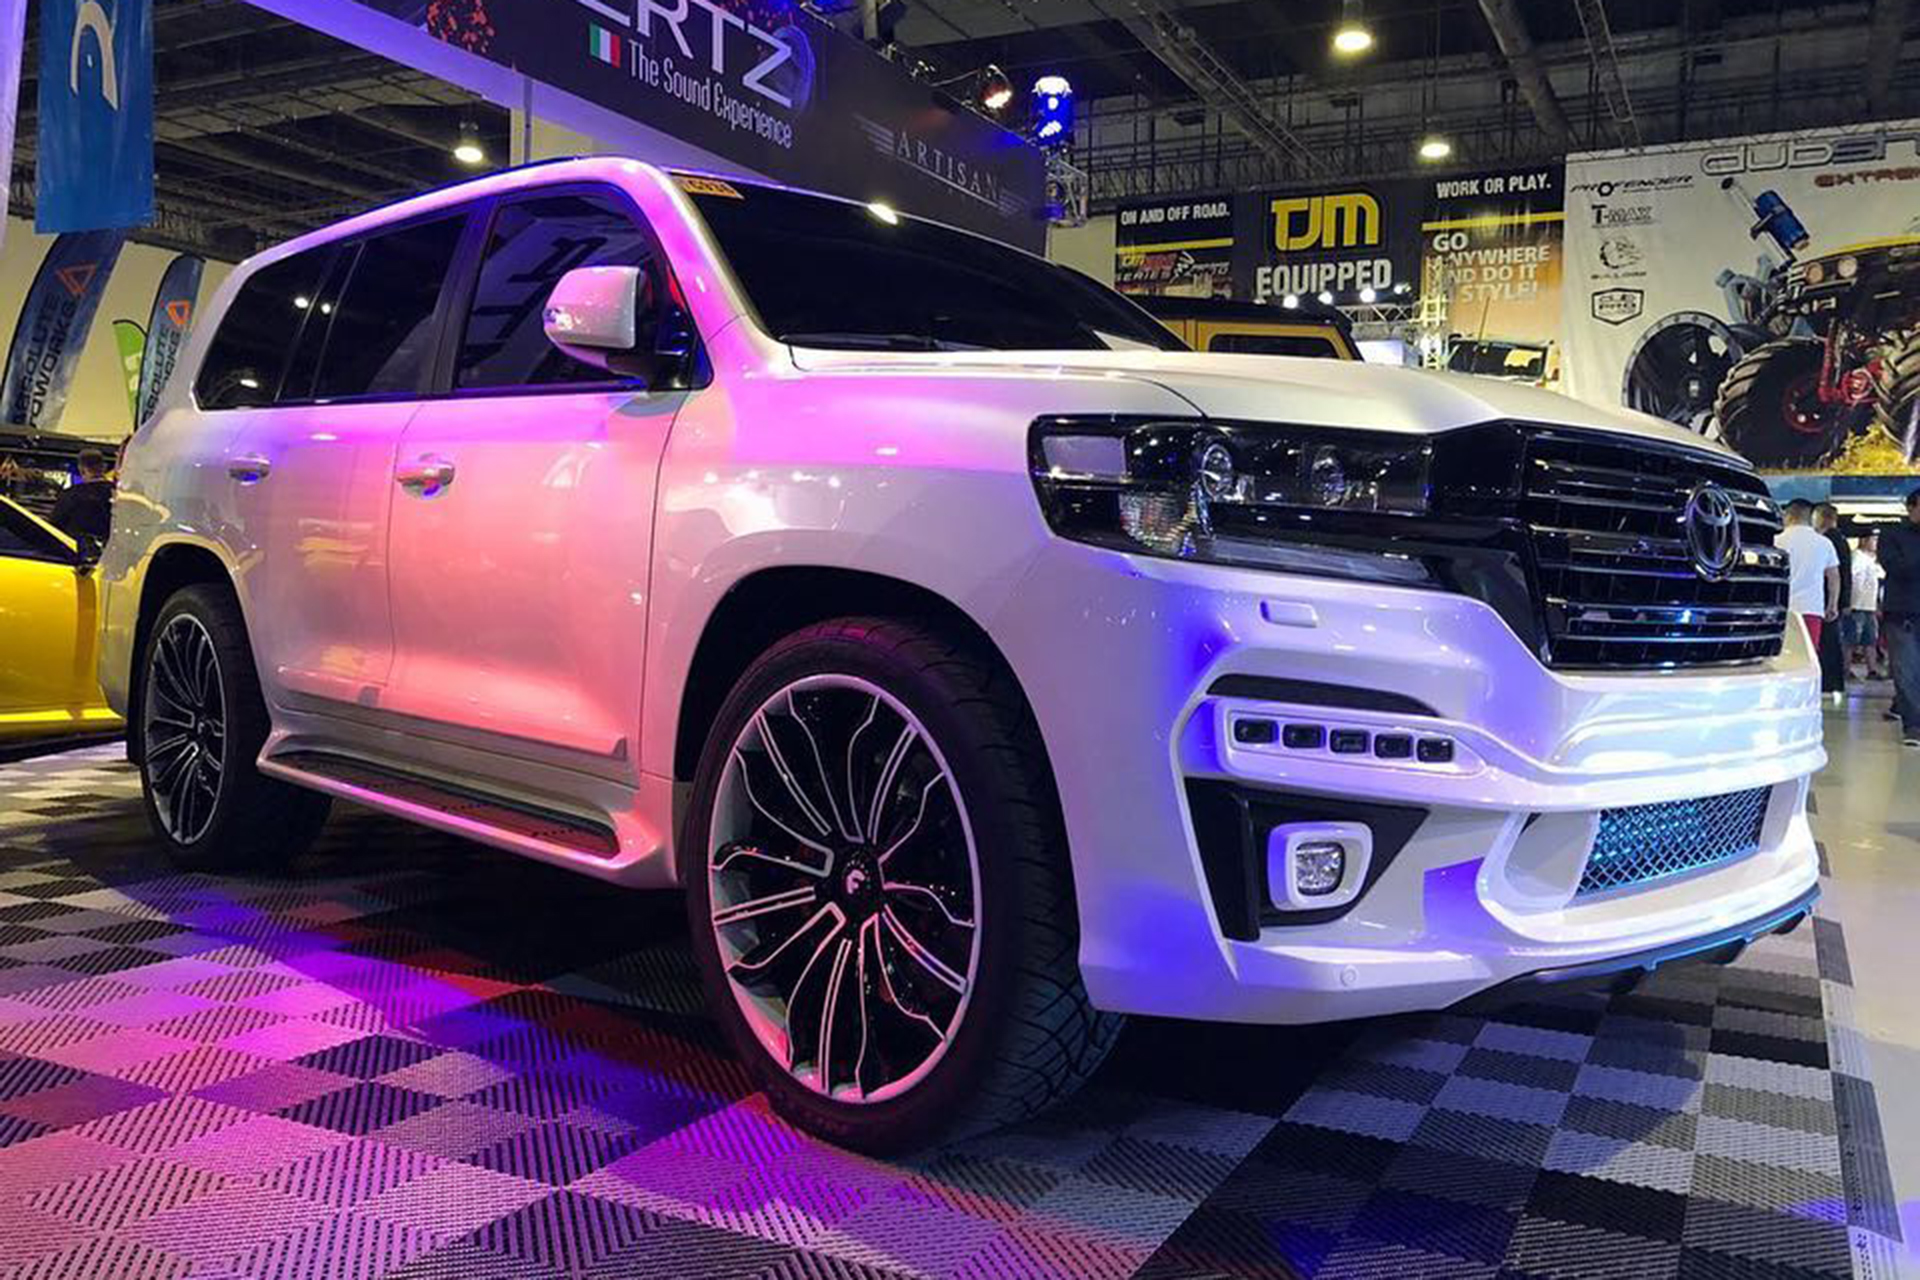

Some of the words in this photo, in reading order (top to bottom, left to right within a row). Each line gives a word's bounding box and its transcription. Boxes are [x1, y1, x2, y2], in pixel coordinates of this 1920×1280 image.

[583, 0, 792, 108] RTZ
[628, 39, 660, 87] The
[663, 57, 711, 111] Sound
[713, 82, 793, 149] Experience
[897, 131, 999, 200] ARTISAN
[1437, 179, 1480, 199] WORK
[1484, 177, 1505, 195] OR
[1508, 172, 1552, 192] PLAY.
[1121, 210, 1138, 226] ON
[1140, 208, 1165, 225] AND
[1167, 206, 1191, 221] OFF
[1193, 202, 1231, 219] ROAD.
[1271, 192, 1379, 252] TJM
[1432, 231, 1469, 253] GO
[1445, 244, 1552, 267] NYWHERE
[1256, 258, 1392, 299] EQUIPPED
[1447, 267, 1477, 284] ND
[1483, 265, 1513, 282] DO
[1519, 263, 1537, 280] IT
[1460, 280, 1538, 302] STYLE!
